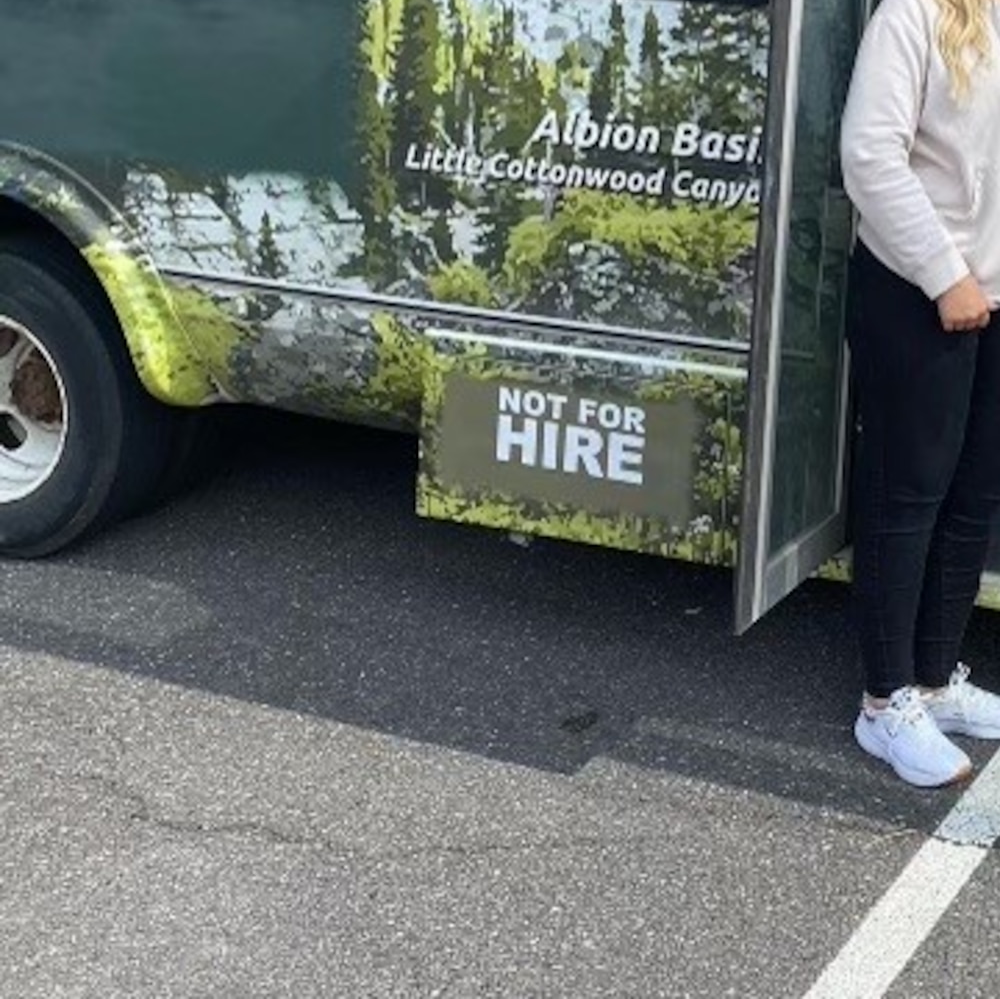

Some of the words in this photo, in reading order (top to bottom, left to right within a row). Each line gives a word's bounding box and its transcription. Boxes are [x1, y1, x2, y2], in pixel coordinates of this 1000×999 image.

[532, 109, 660, 154] Albion
[671, 121, 763, 164] Basi
[404, 143, 483, 175] Little
[487, 152, 665, 195] Cottonwood
[499, 385, 568, 420] NOT
[578, 398, 646, 434] FOR
[496, 414, 646, 485] HIRE
